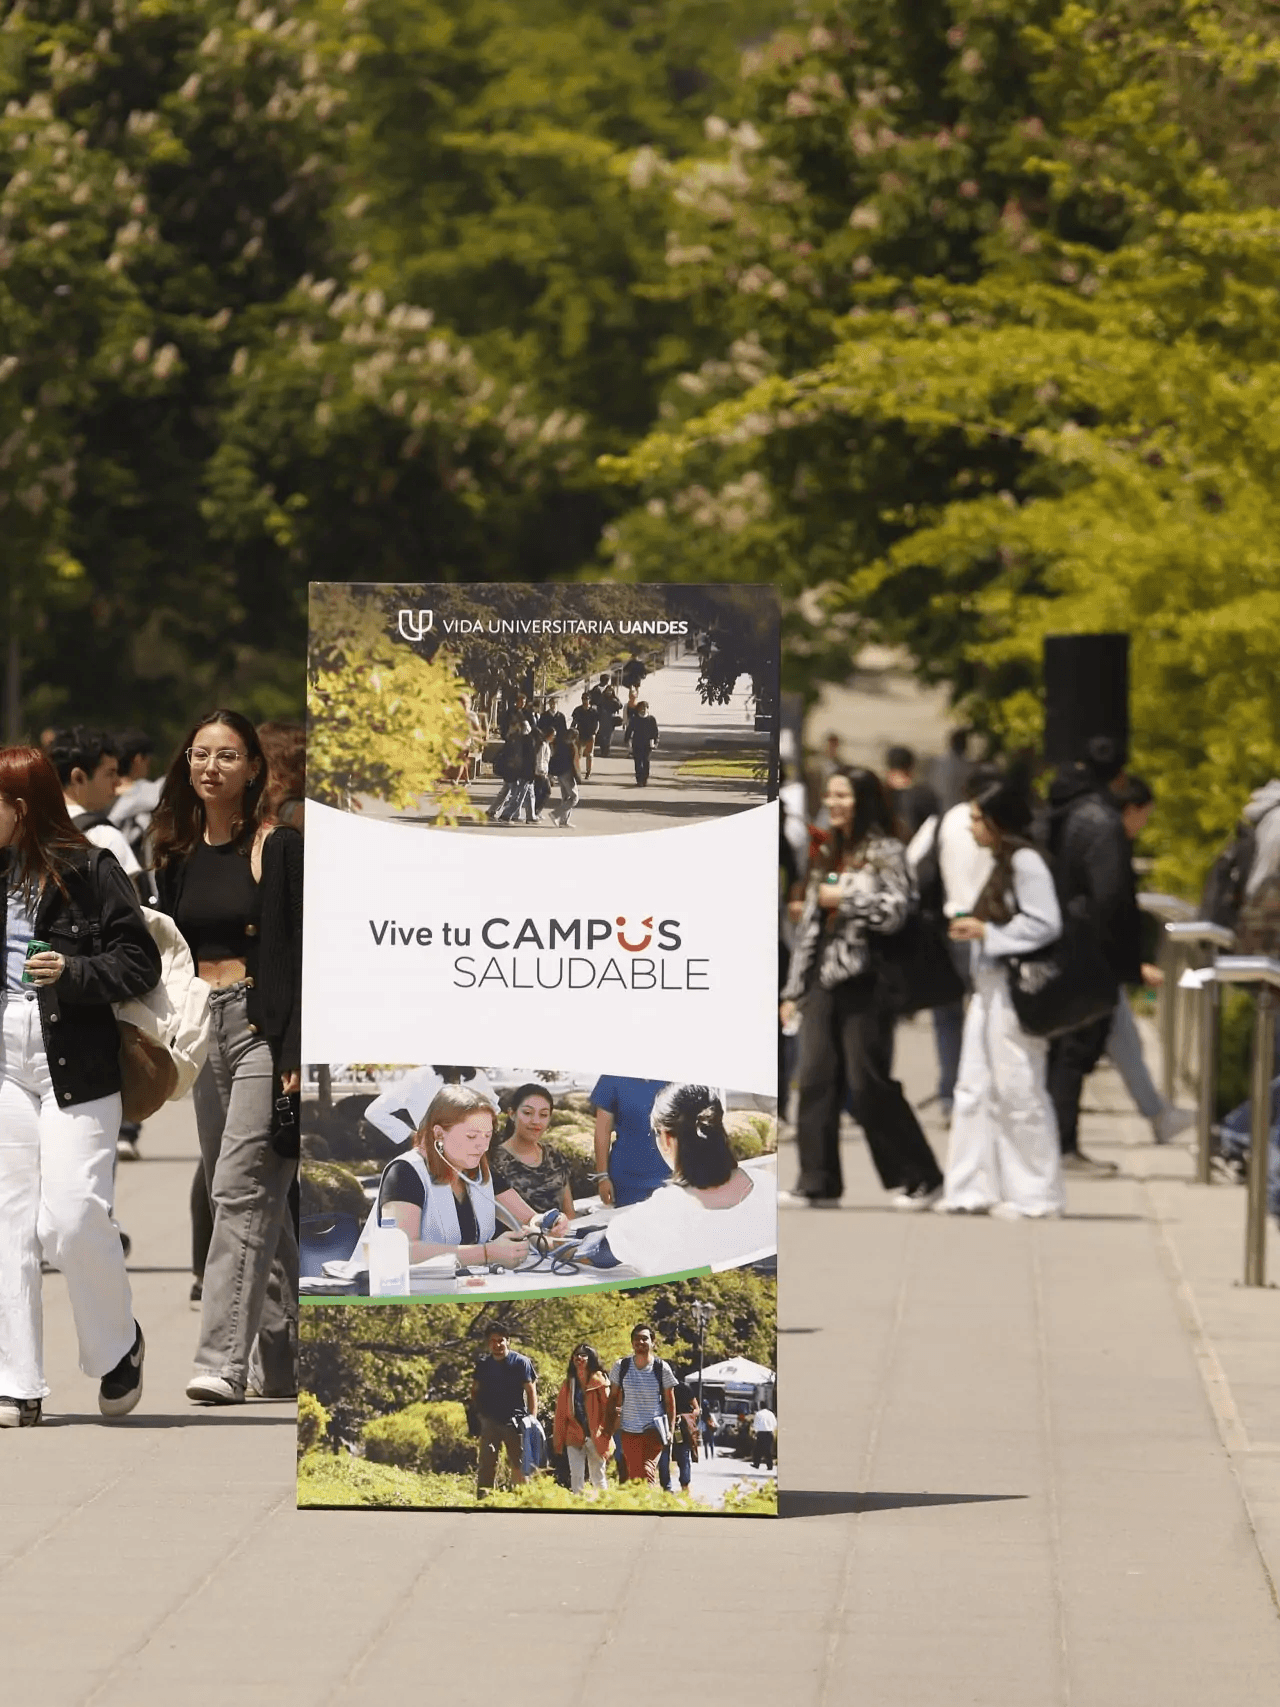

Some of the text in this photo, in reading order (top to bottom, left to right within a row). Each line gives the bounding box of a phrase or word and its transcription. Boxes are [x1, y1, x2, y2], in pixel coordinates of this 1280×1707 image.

[442, 619, 689, 635] VIDA UNIVERSITARIA UANDES
[368, 915, 682, 952] Vive tu CAMPUS
[452, 956, 710, 990] SALUDABLE
